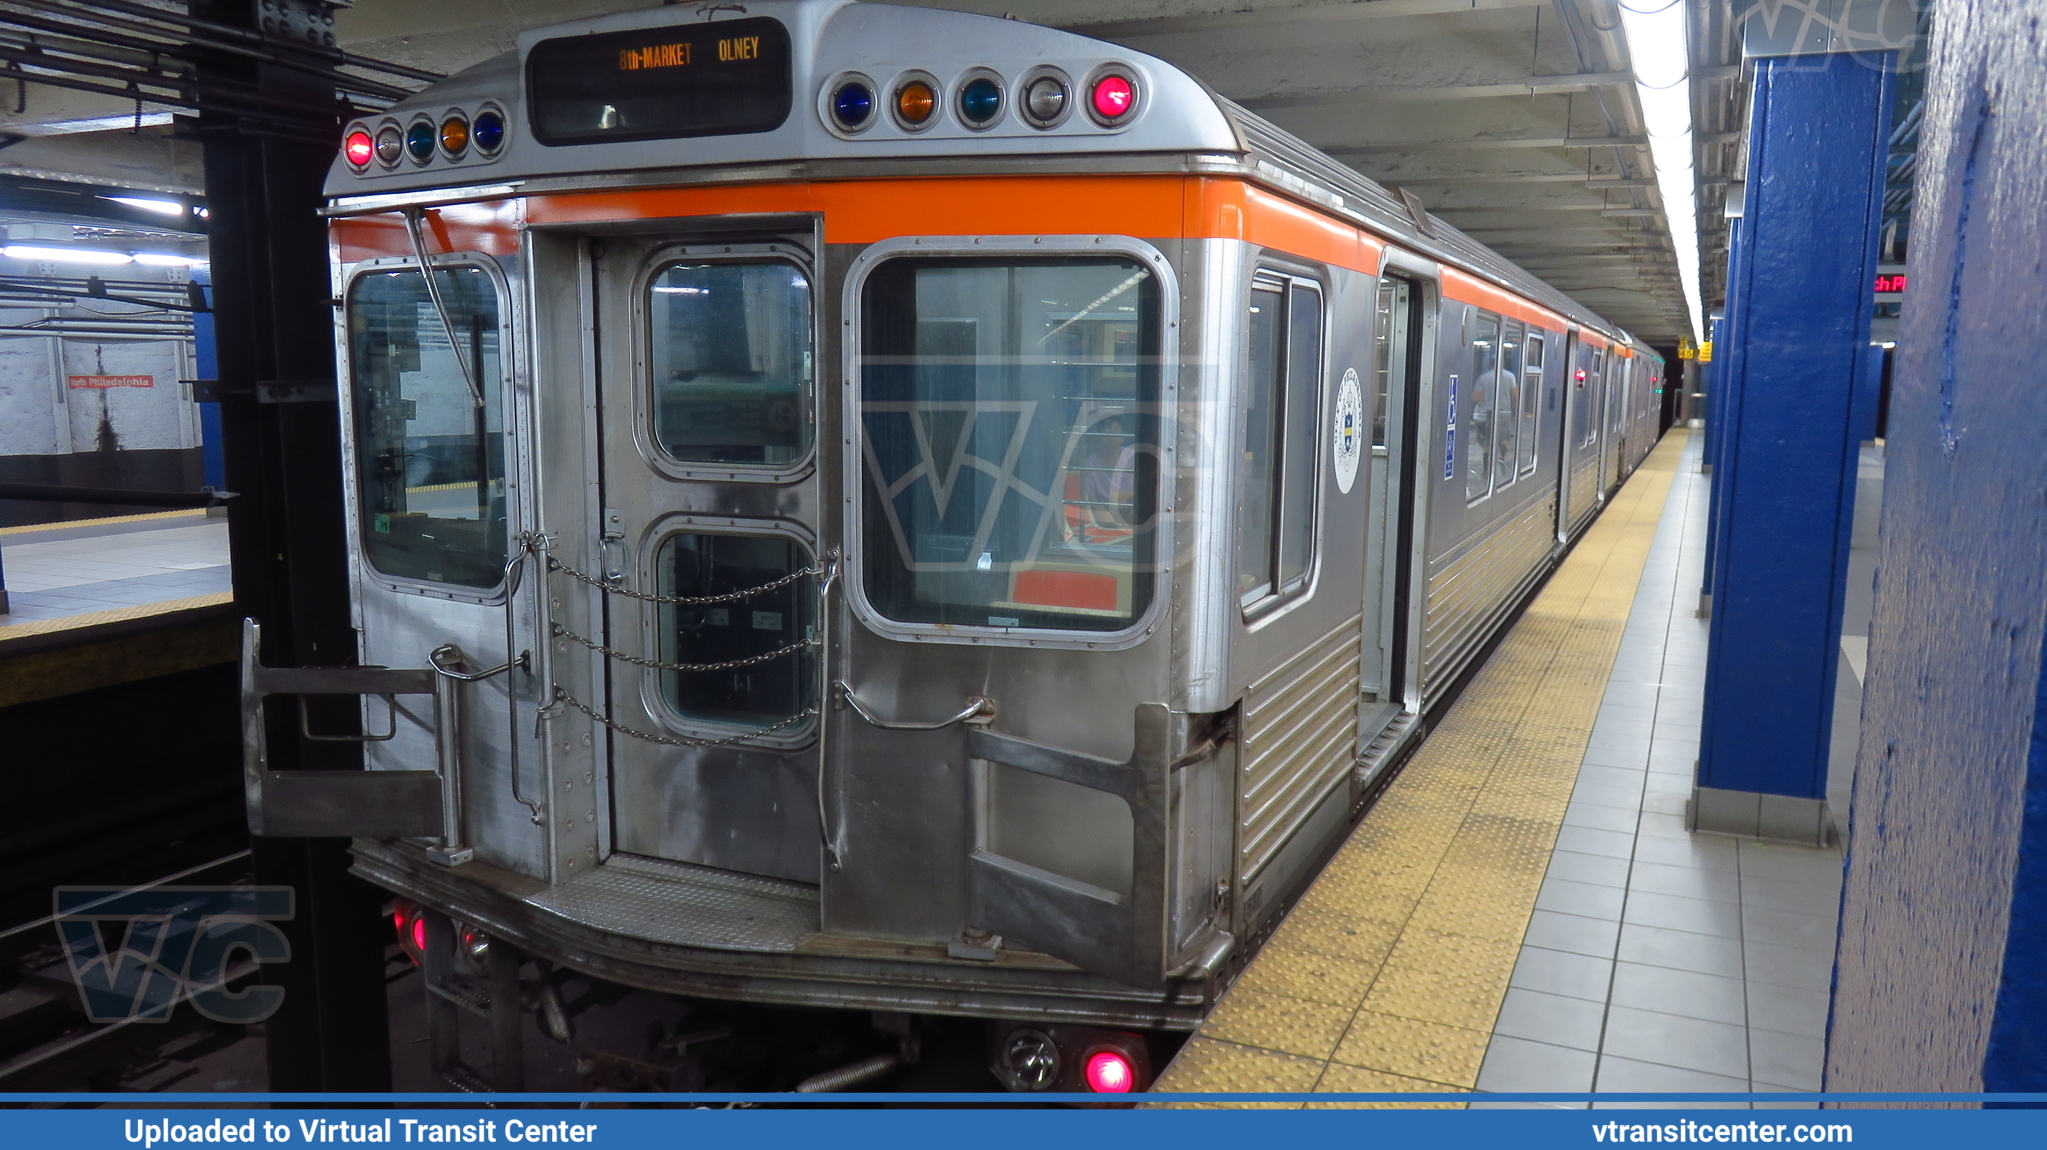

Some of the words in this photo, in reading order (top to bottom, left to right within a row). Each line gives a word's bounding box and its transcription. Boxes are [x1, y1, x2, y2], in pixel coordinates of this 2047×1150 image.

[619, 42, 692, 71] 8th-MARKET
[718, 36, 760, 62] OLNEY
[89, 378, 150, 386] Philadelphia
